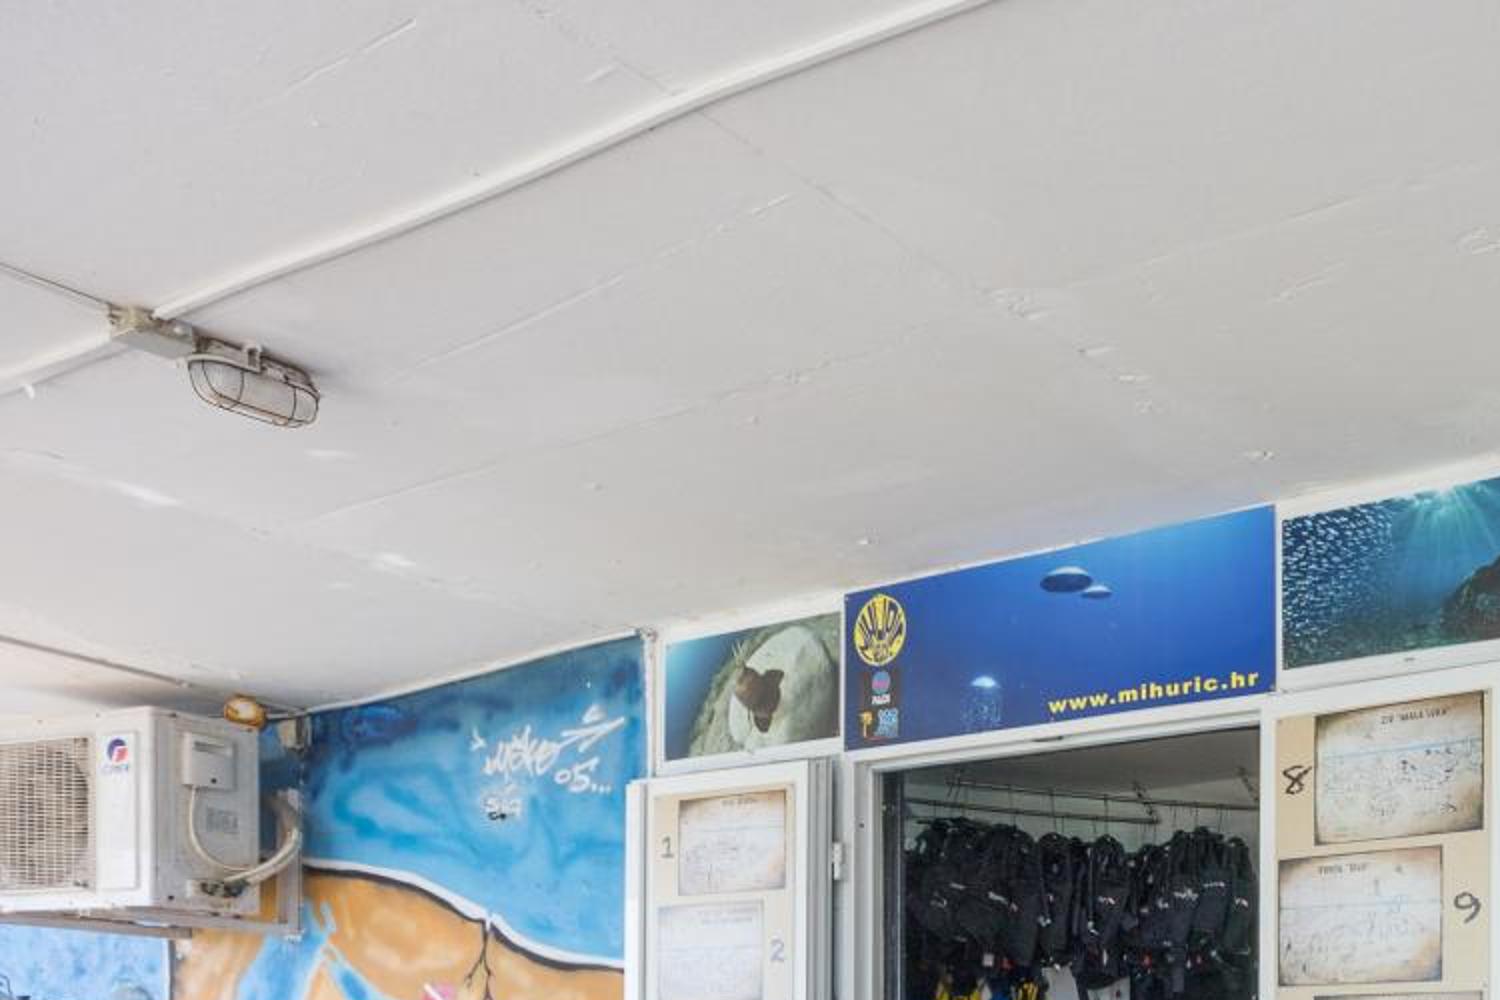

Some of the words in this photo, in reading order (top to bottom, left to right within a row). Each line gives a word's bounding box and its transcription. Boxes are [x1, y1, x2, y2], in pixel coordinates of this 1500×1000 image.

[1048, 671, 1260, 715] www.mihuric.hr
[1282, 765, 1313, 796] 8
[661, 836, 675, 859] 1
[1454, 891, 1481, 924] 9
[770, 938, 785, 964] 2
